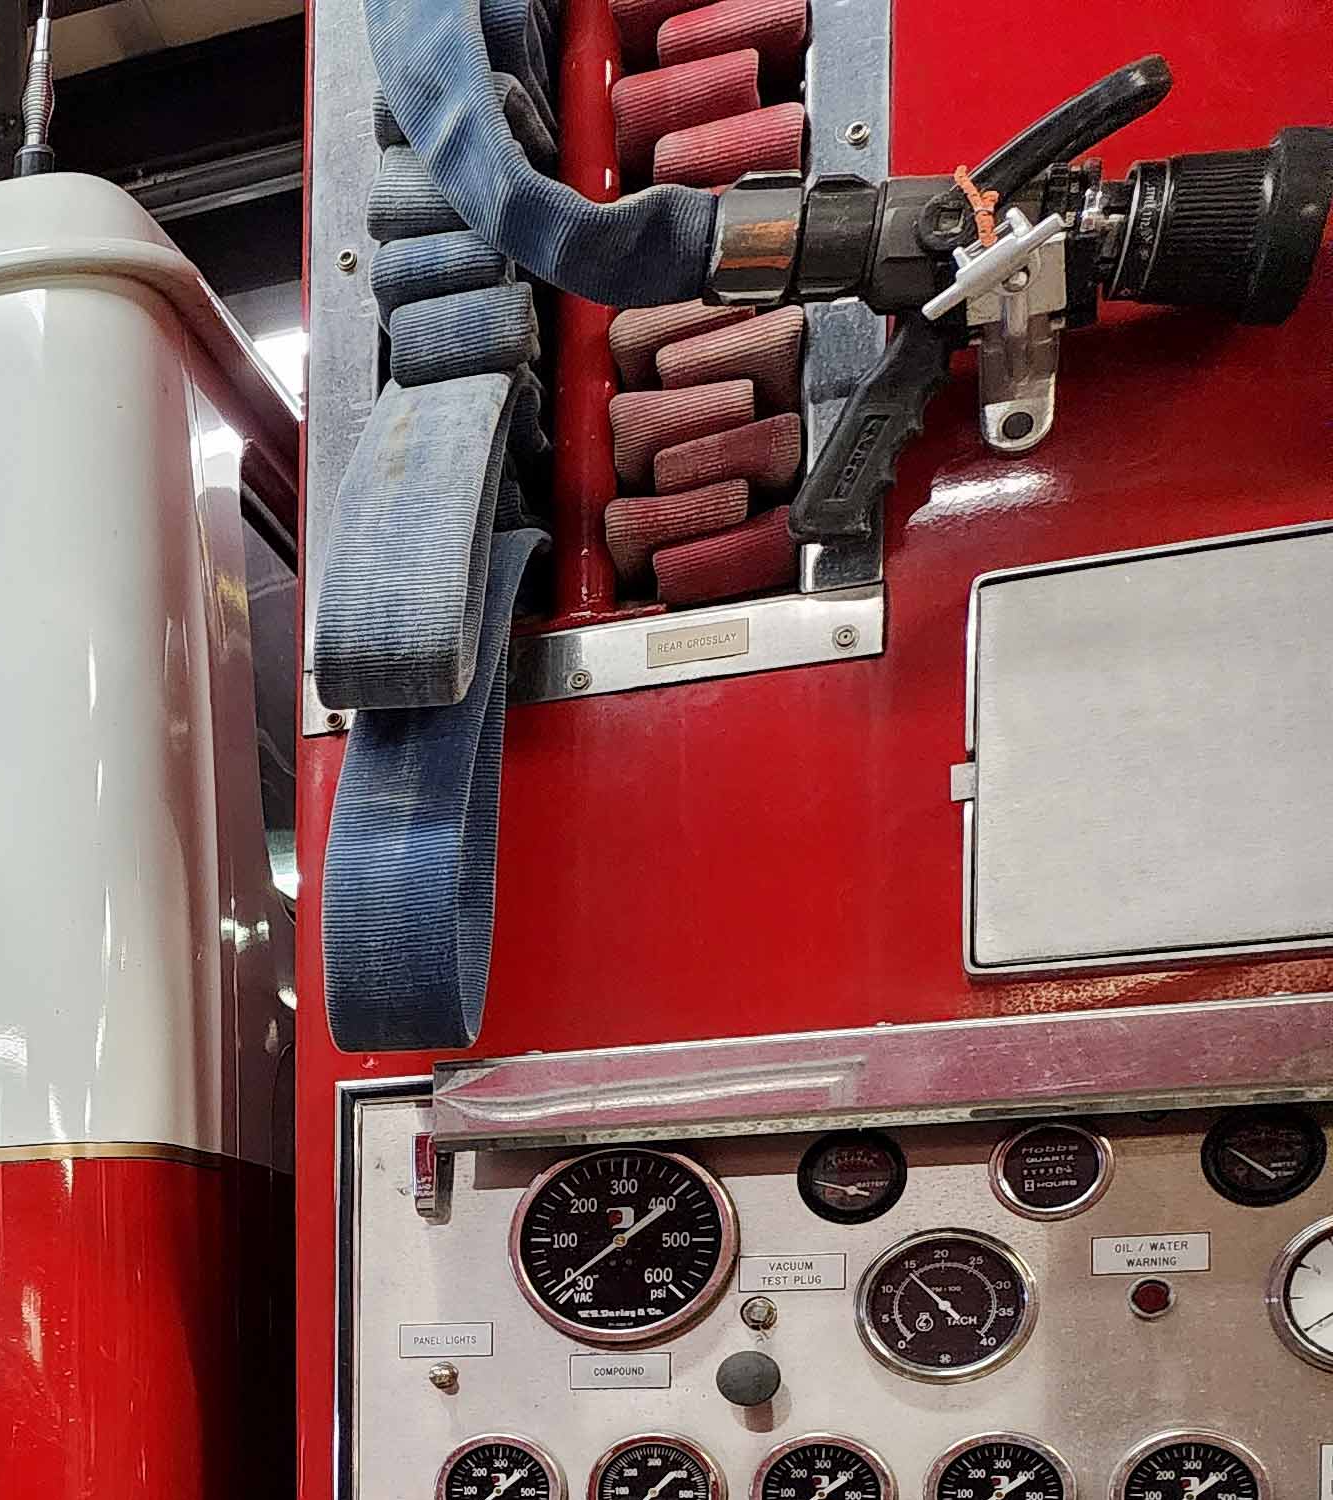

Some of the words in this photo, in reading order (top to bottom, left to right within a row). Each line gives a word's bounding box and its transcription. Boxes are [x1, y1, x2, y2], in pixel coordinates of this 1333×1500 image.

[657, 641, 682, 653] REAR
[687, 633, 737, 649] CROSSLAY
[610, 1179, 638, 1195] 300
[569, 1198, 597, 1213] 200
[648, 1196, 676, 1211] 400
[552, 1233, 578, 1248] 100
[662, 1232, 690, 1247] 500
[1115, 1243, 1133, 1253] OIL
[1149, 1240, 1189, 1251] WATER
[933, 1250, 949, 1259] 20
[904, 1260, 917, 1269] 15
[969, 1256, 983, 1265] 25
[1126, 1256, 1177, 1267] WARNING
[768, 1262, 813, 1272] VACUUM
[564, 1268, 574, 1281] 0
[644, 1268, 673, 1283] 600
[761, 1276, 788, 1286] TEST
[793, 1275, 822, 1285] PLUG
[996, 1281, 1011, 1289] 30
[650, 1286, 666, 1300] psi
[882, 1285, 893, 1294] 10
[573, 1292, 593, 1303] VAC
[999, 1308, 1014, 1316] 35
[882, 1315, 890, 1323] 5
[945, 1316, 978, 1326] TACH
[413, 1336, 441, 1345] PANEL
[445, 1334, 477, 1345] LIGHTS
[980, 1337, 996, 1346] 40
[897, 1341, 906, 1349] 0
[593, 1366, 645, 1376] COMPOUND
[493, 1459, 508, 1467] 300
[647, 1458, 661, 1466] 300
[814, 1460, 831, 1469] 300
[993, 1459, 1011, 1469] 300
[1182, 1461, 1202, 1470] 300
[472, 1468, 487, 1477] 200
[623, 1468, 638, 1477] 200
[791, 1469, 807, 1478] 200
[837, 1471, 853, 1480] 400
[968, 1469, 986, 1478] 200
[1017, 1471, 1035, 1480] 400
[1156, 1471, 1175, 1480] 200
[1209, 1472, 1227, 1481] 400
[463, 1487, 477, 1495] 100
[521, 1488, 535, 1496] 500
[615, 1487, 629, 1495] 100
[679, 1490, 693, 1498] 500
[780, 1488, 795, 1497] 100
[844, 1491, 862, 1500] 500
[957, 1489, 973, 1498] 100
[1144, 1491, 1162, 1500] 100
[1025, 1492, 1043, 1500] 500
